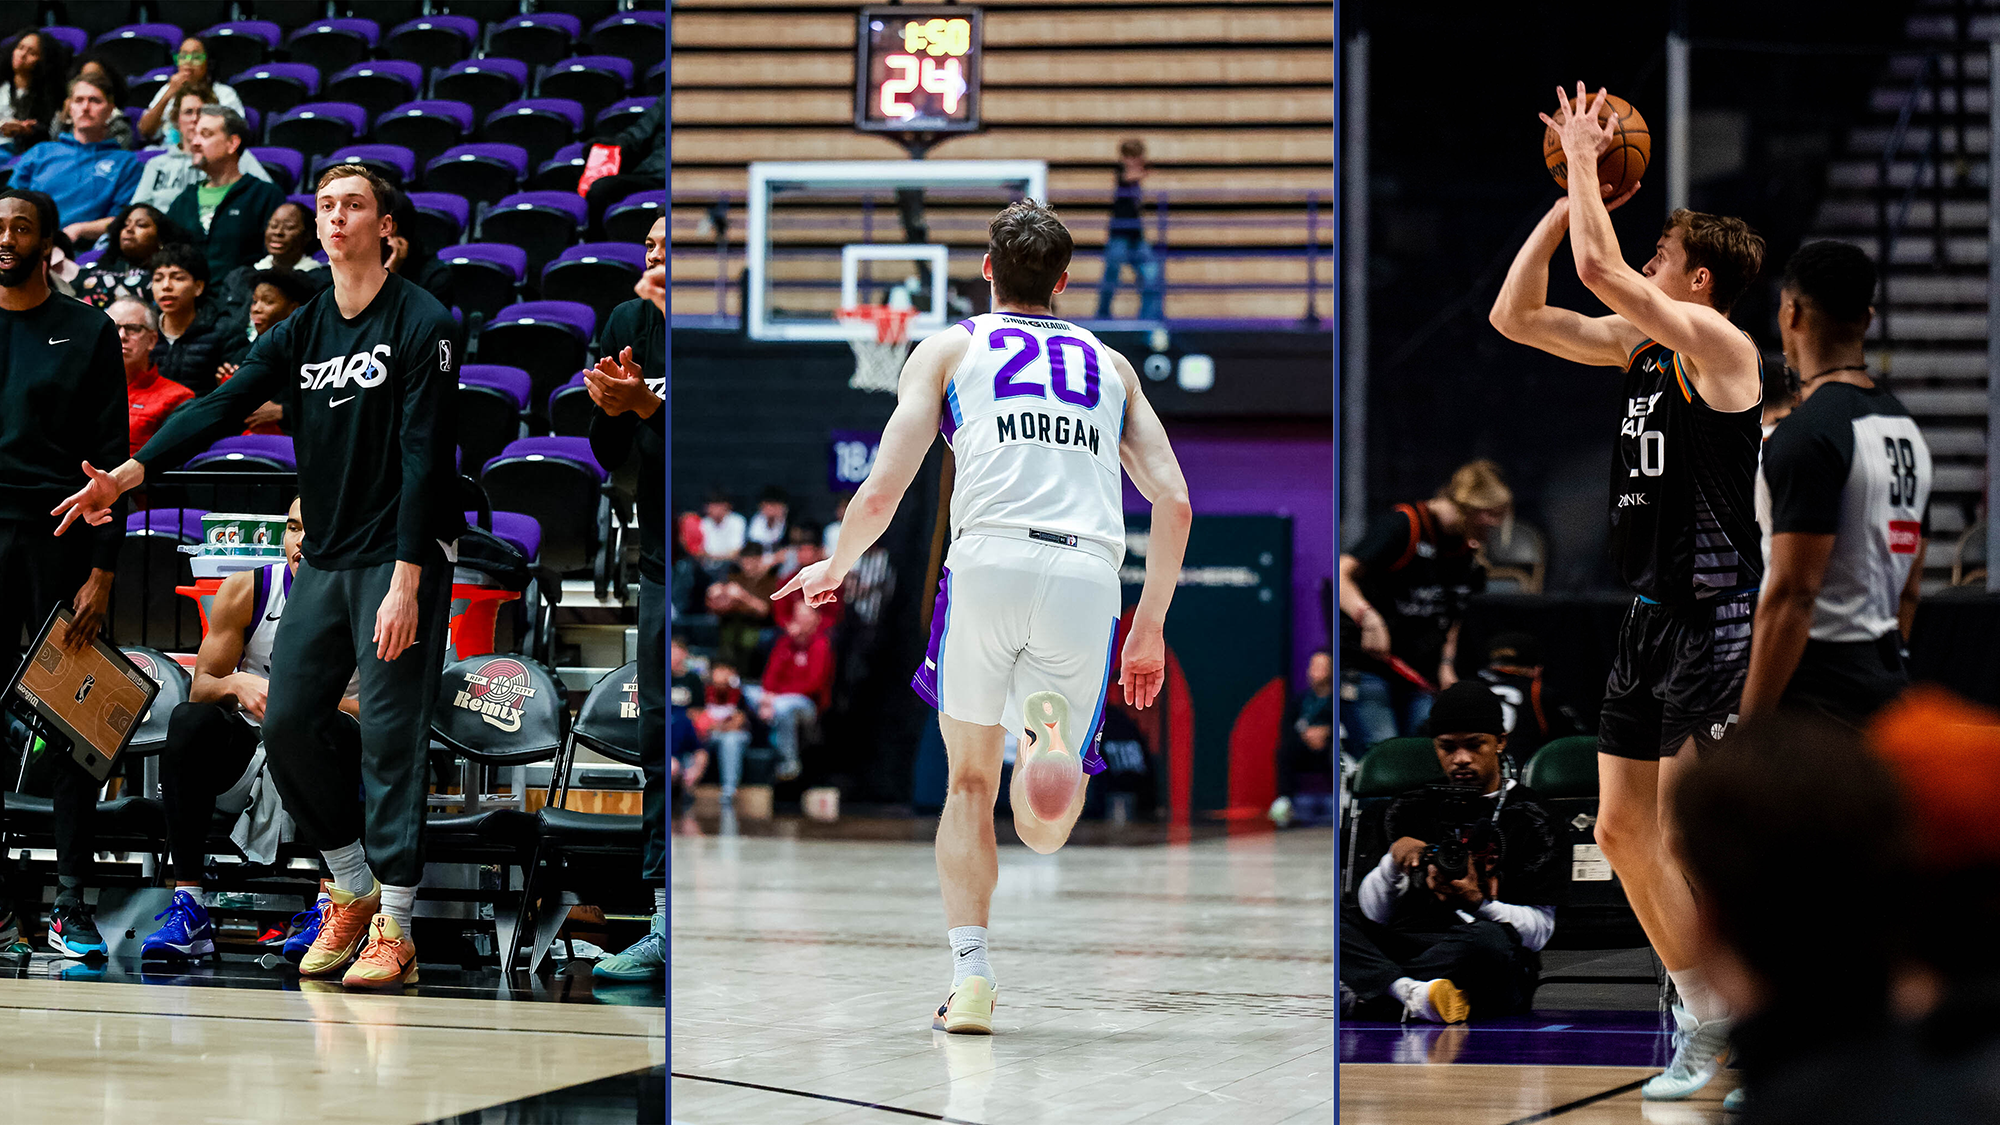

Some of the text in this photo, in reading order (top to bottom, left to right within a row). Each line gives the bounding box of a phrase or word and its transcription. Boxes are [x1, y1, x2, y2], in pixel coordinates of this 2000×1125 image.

[905, 18, 970, 56] 1:50
[881, 54, 960, 117] 24
[301, 344, 391, 390] STARS
[988, 327, 1101, 411] 20
[996, 412, 1100, 456] MORGAN
[1884, 436, 1916, 507] 38
[17, 683, 39, 708] Wilson
[453, 690, 525, 732] Remix
[514, 686, 532, 695] CITY
